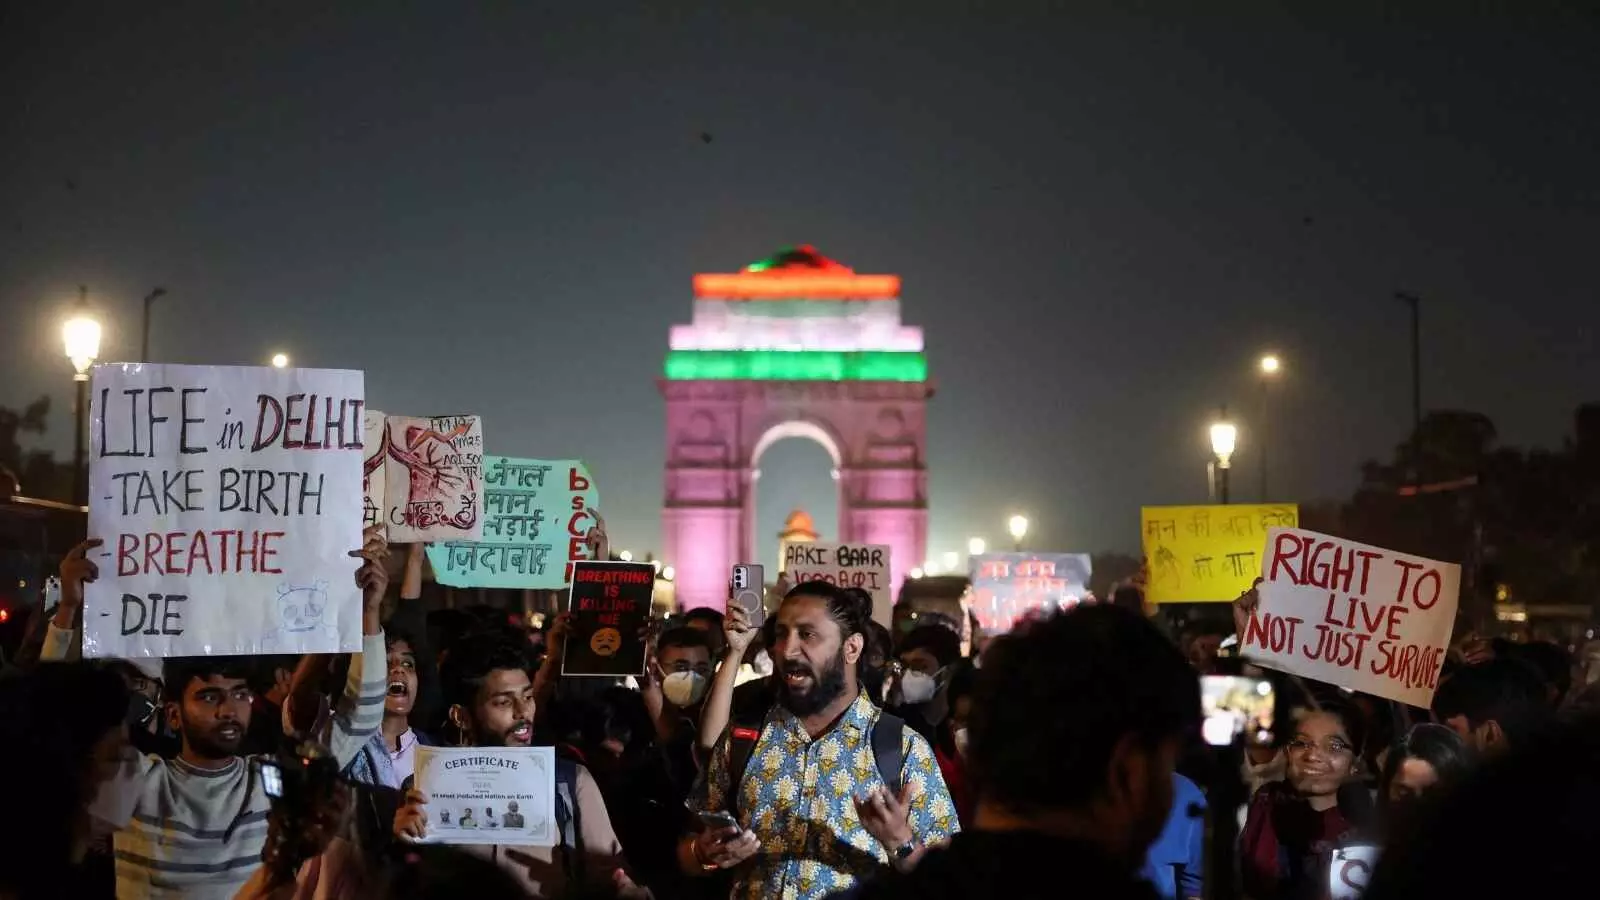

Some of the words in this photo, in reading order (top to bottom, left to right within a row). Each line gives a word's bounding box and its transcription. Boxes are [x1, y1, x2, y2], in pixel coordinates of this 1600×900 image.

[100, 386, 208, 458] LIFE
[216, 408, 245, 450] in
[251, 393, 364, 453] DELHI
[219, 467, 325, 517] BIRTH
[485, 457, 553, 487] जंगल
[117, 530, 286, 577] BREATHE
[786, 545, 828, 567] ABKI
[837, 545, 884, 568] BAAR
[1269, 532, 1384, 596] RIGHT
[1394, 559, 1442, 610] TO
[576, 568, 651, 584] BREATHING
[604, 584, 620, 597] IS
[121, 593, 188, 636] DIE
[578, 596, 636, 612] KILLING
[1325, 592, 1410, 641] LIVE
[1246, 606, 1305, 656] NOT
[1302, 623, 1372, 671] JUST
[1370, 640, 1445, 690] SURVIVE
[445, 756, 520, 771] CERTIFICATE
